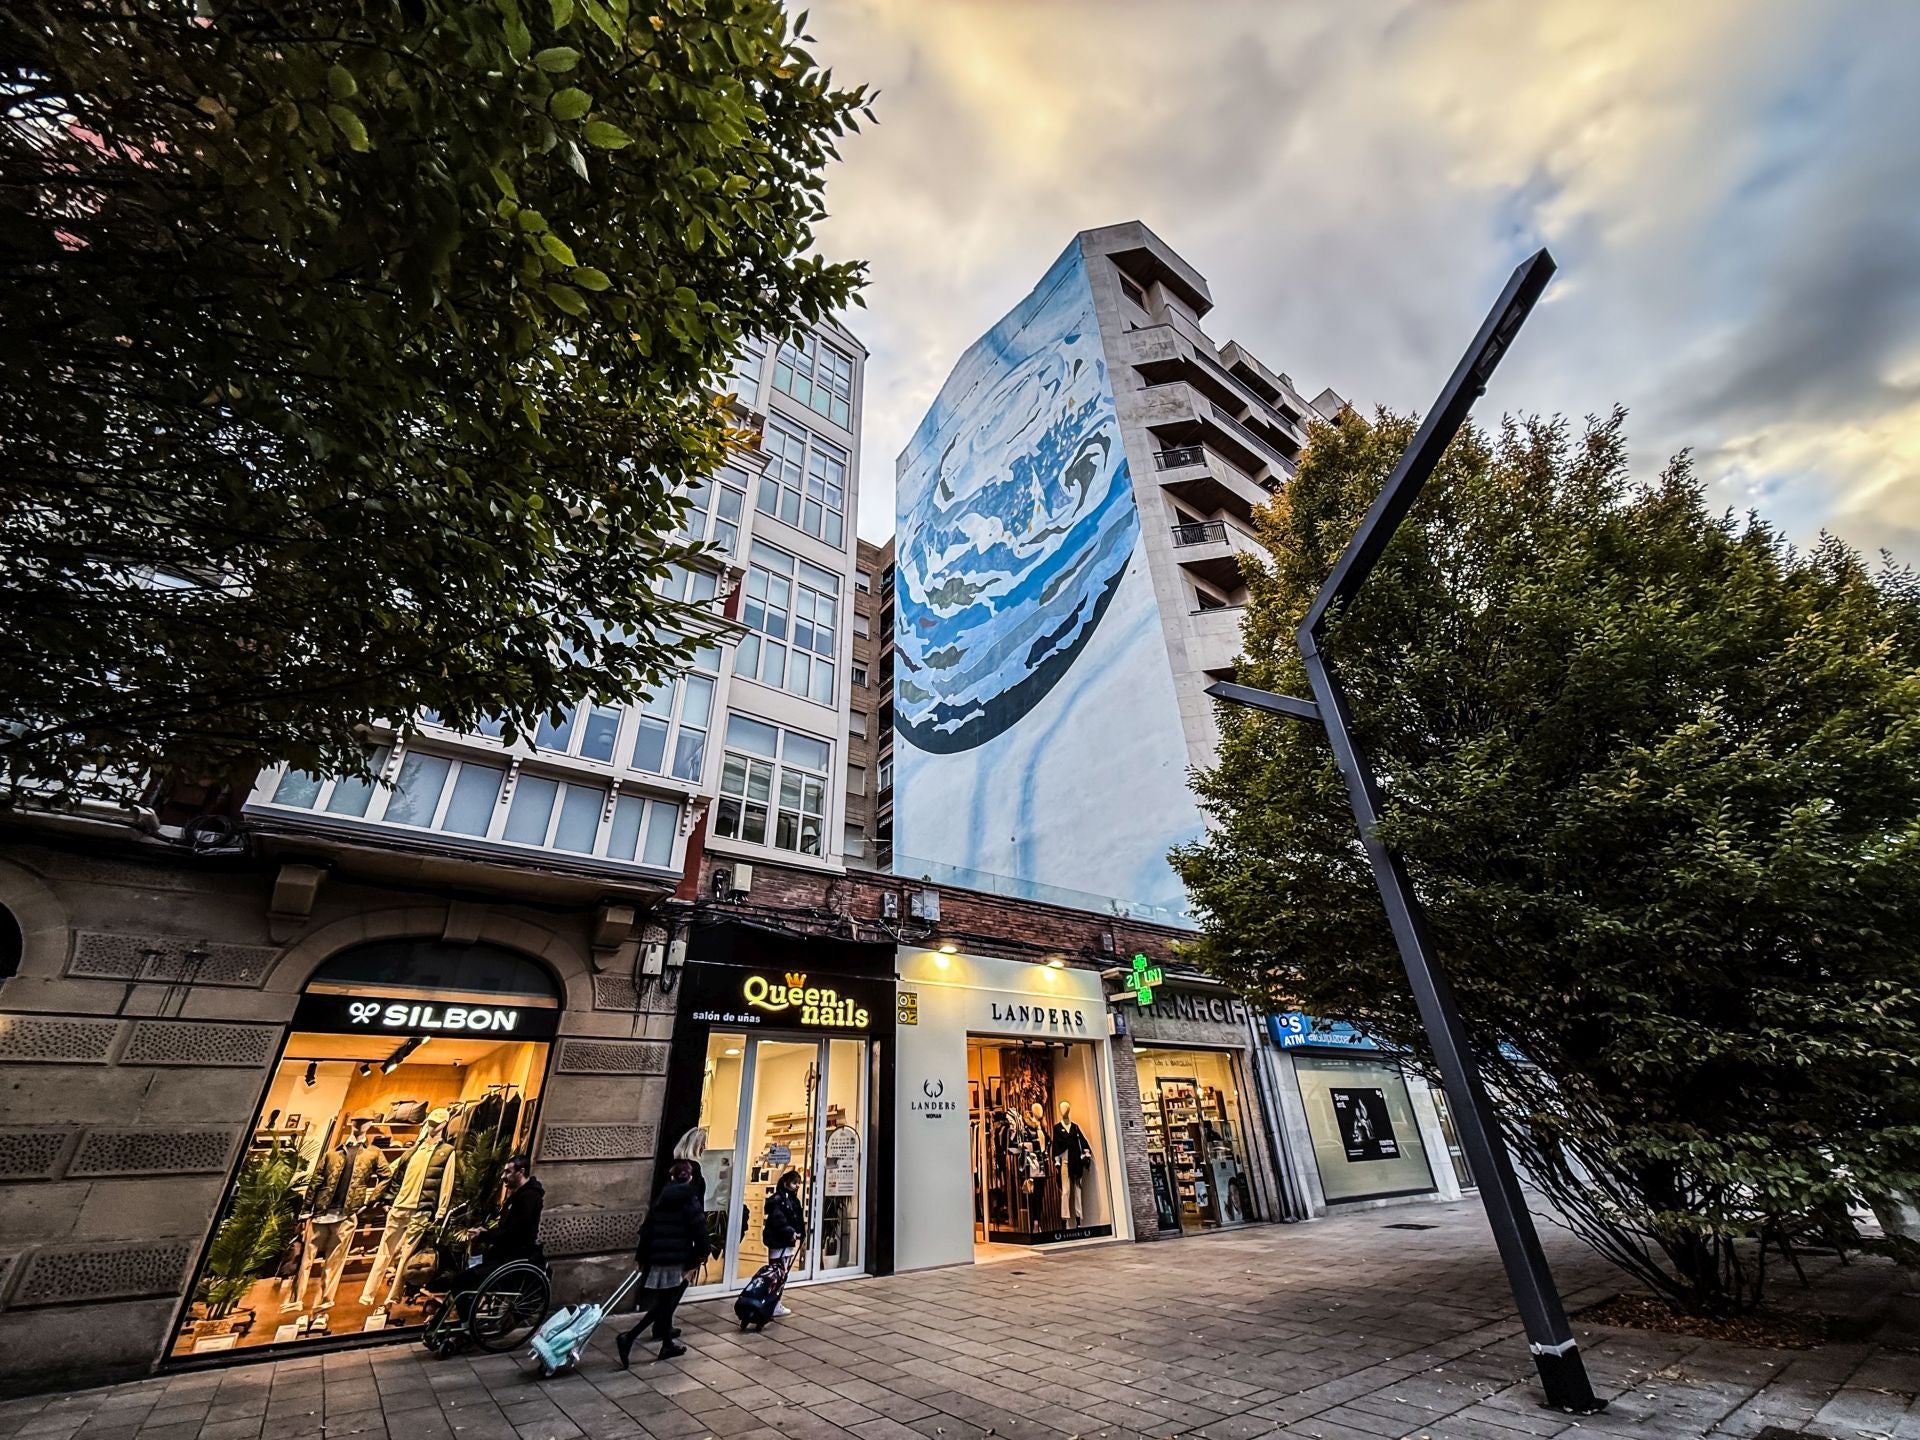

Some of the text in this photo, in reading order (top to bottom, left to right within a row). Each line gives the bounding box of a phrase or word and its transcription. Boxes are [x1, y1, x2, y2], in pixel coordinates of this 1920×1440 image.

[743, 975, 838, 1011] Queen
[382, 1004, 518, 1031] SILBON
[692, 1010, 761, 1023] salón de uñas
[800, 998, 870, 1028] nails
[991, 1003, 1083, 1026] LANDERS
[1284, 1035, 1305, 1047] ATM
[911, 1101, 956, 1111] LANDERS
